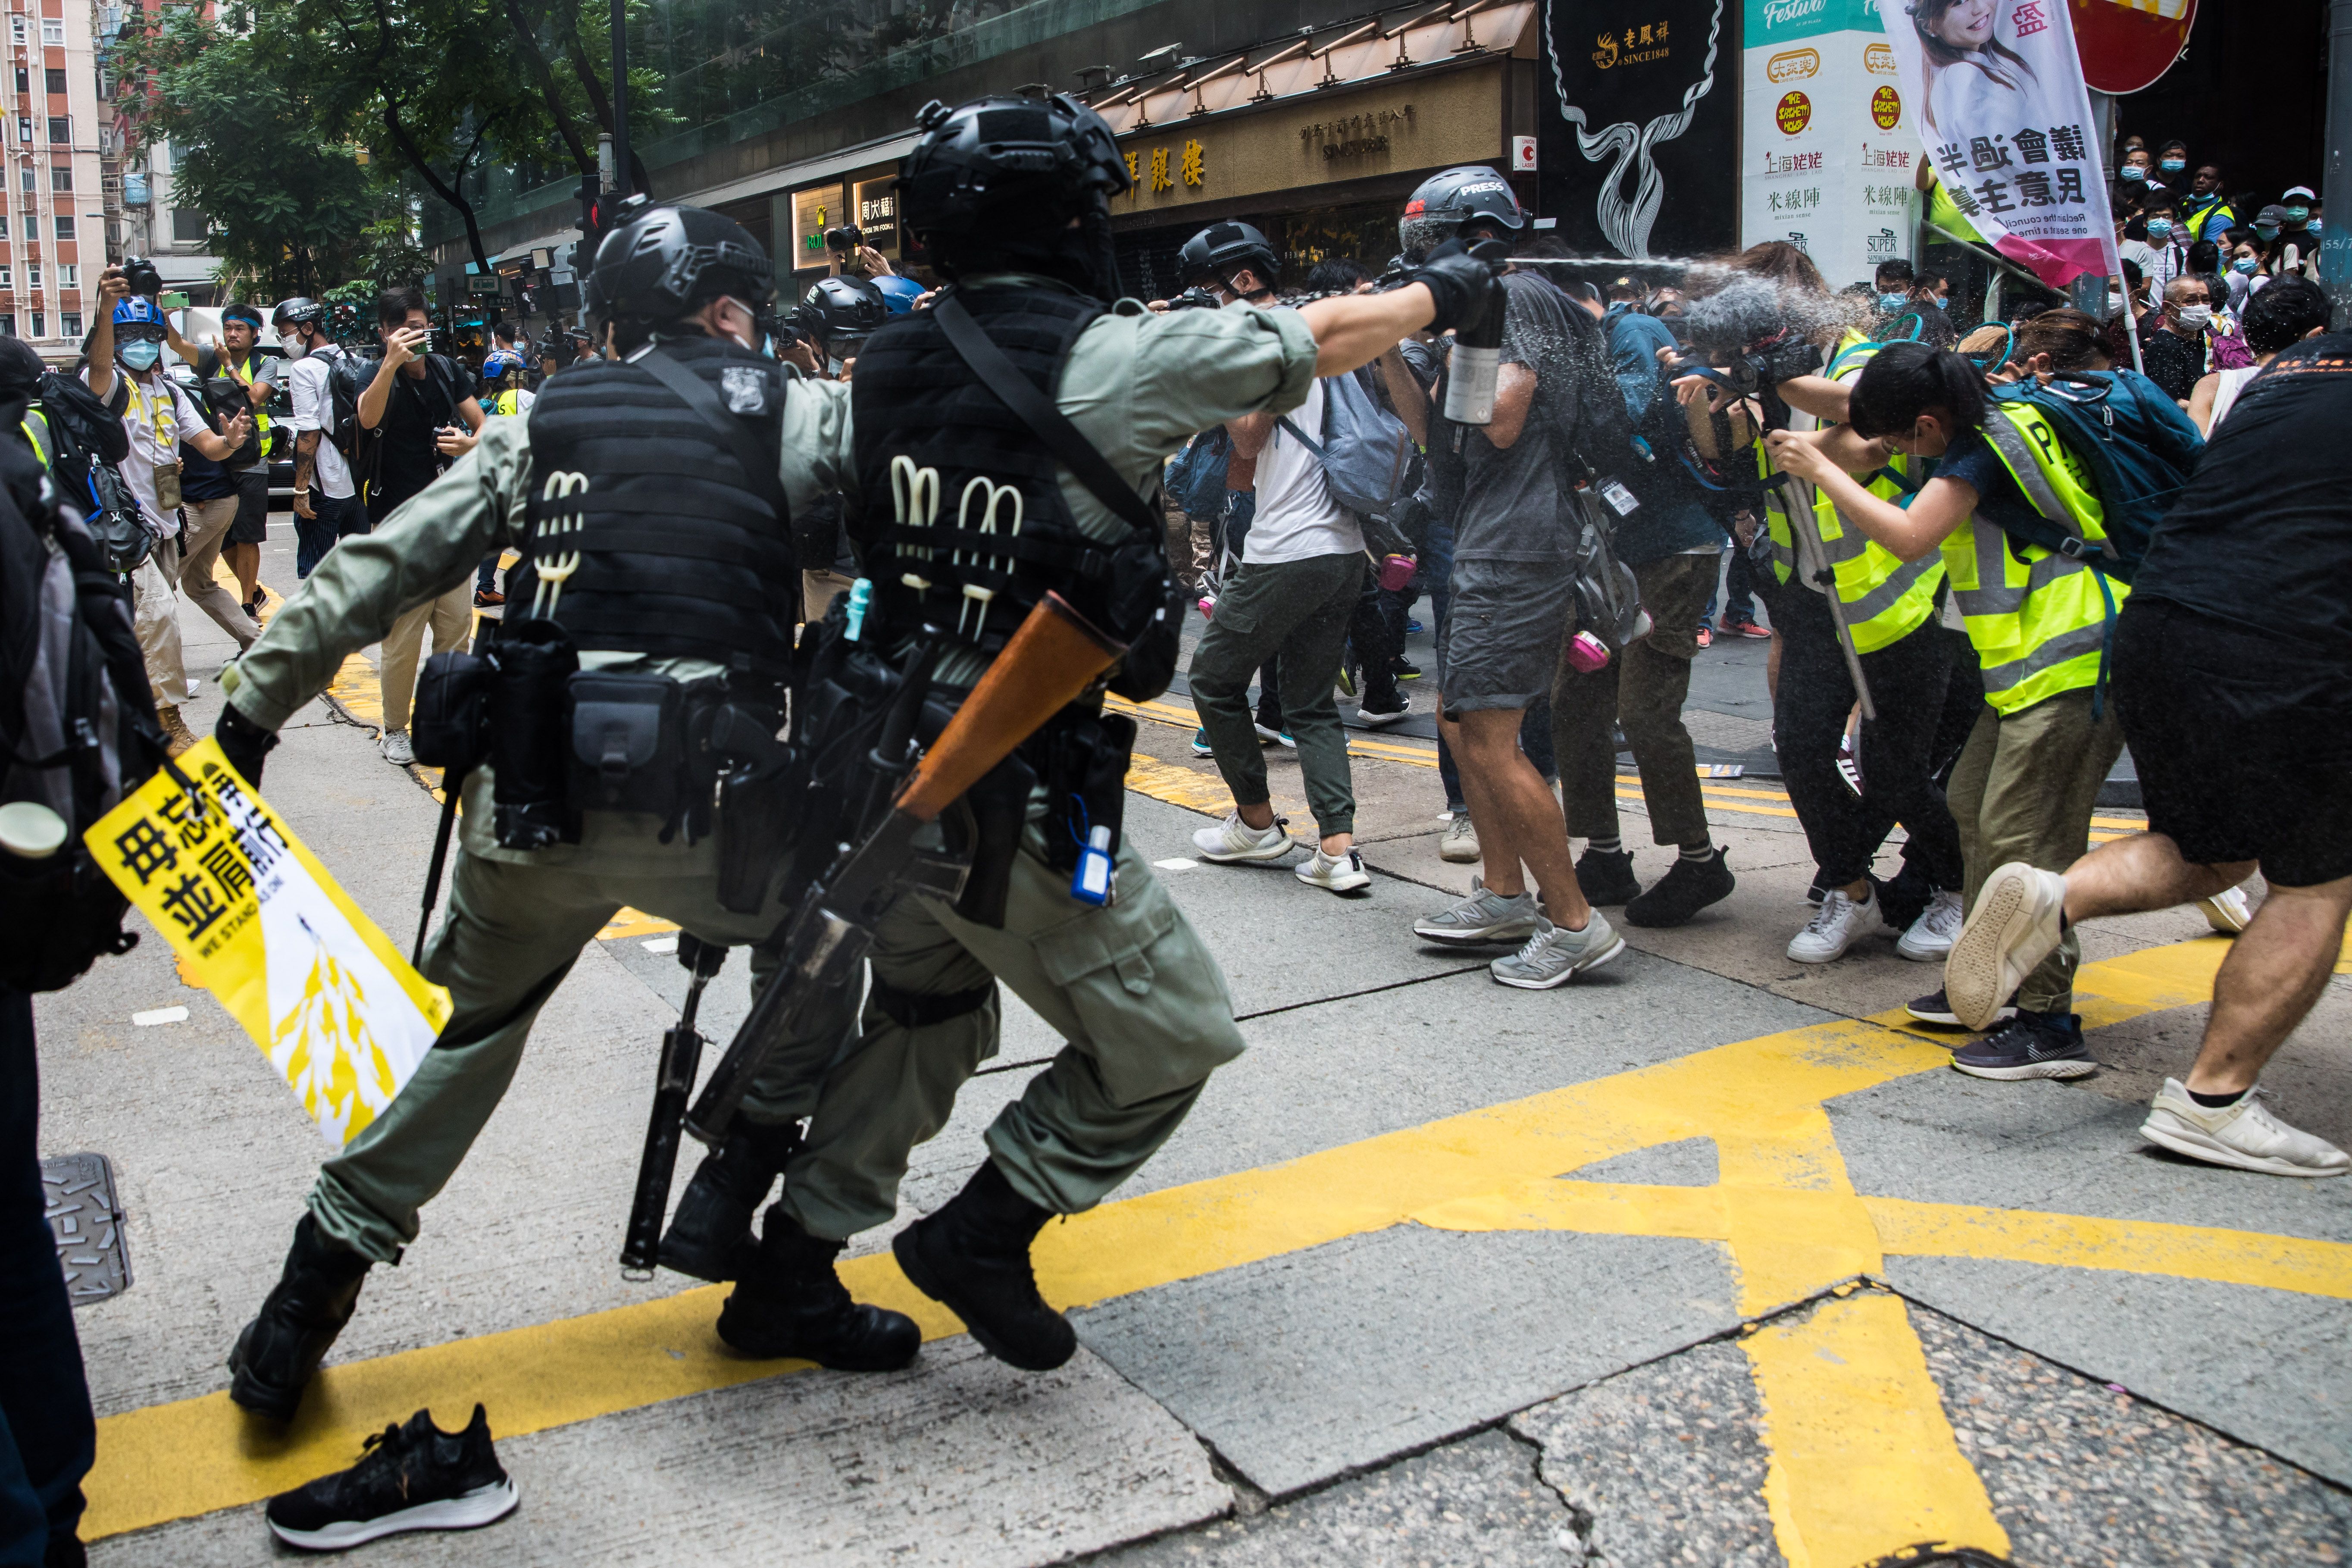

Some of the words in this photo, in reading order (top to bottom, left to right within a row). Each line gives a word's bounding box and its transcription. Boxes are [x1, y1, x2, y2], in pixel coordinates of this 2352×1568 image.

[1624, 20, 1669, 49] 老鳳祥
[1785, 93, 1801, 105] THE
[1879, 88, 1892, 100] THE
[1784, 119, 1805, 132] HOUSE
[1878, 115, 1895, 127] HOUSE
[1765, 151, 1823, 174] 上海姥姥
[1861, 142, 1910, 168] 上海姥姥
[1460, 182, 1504, 196] PRESS
[1862, 185, 1907, 207] 米線陣
[1767, 187, 1820, 212] 米線陣
[862, 197, 891, 221] 周大福
[807, 233, 825, 250] ROL
[1867, 238, 1896, 252] SUPER
[301, 303, 321, 312] PRESS
[219, 901, 259, 940] STAND
[258, 890, 271, 905] AS
[268, 874, 285, 894] ONE
